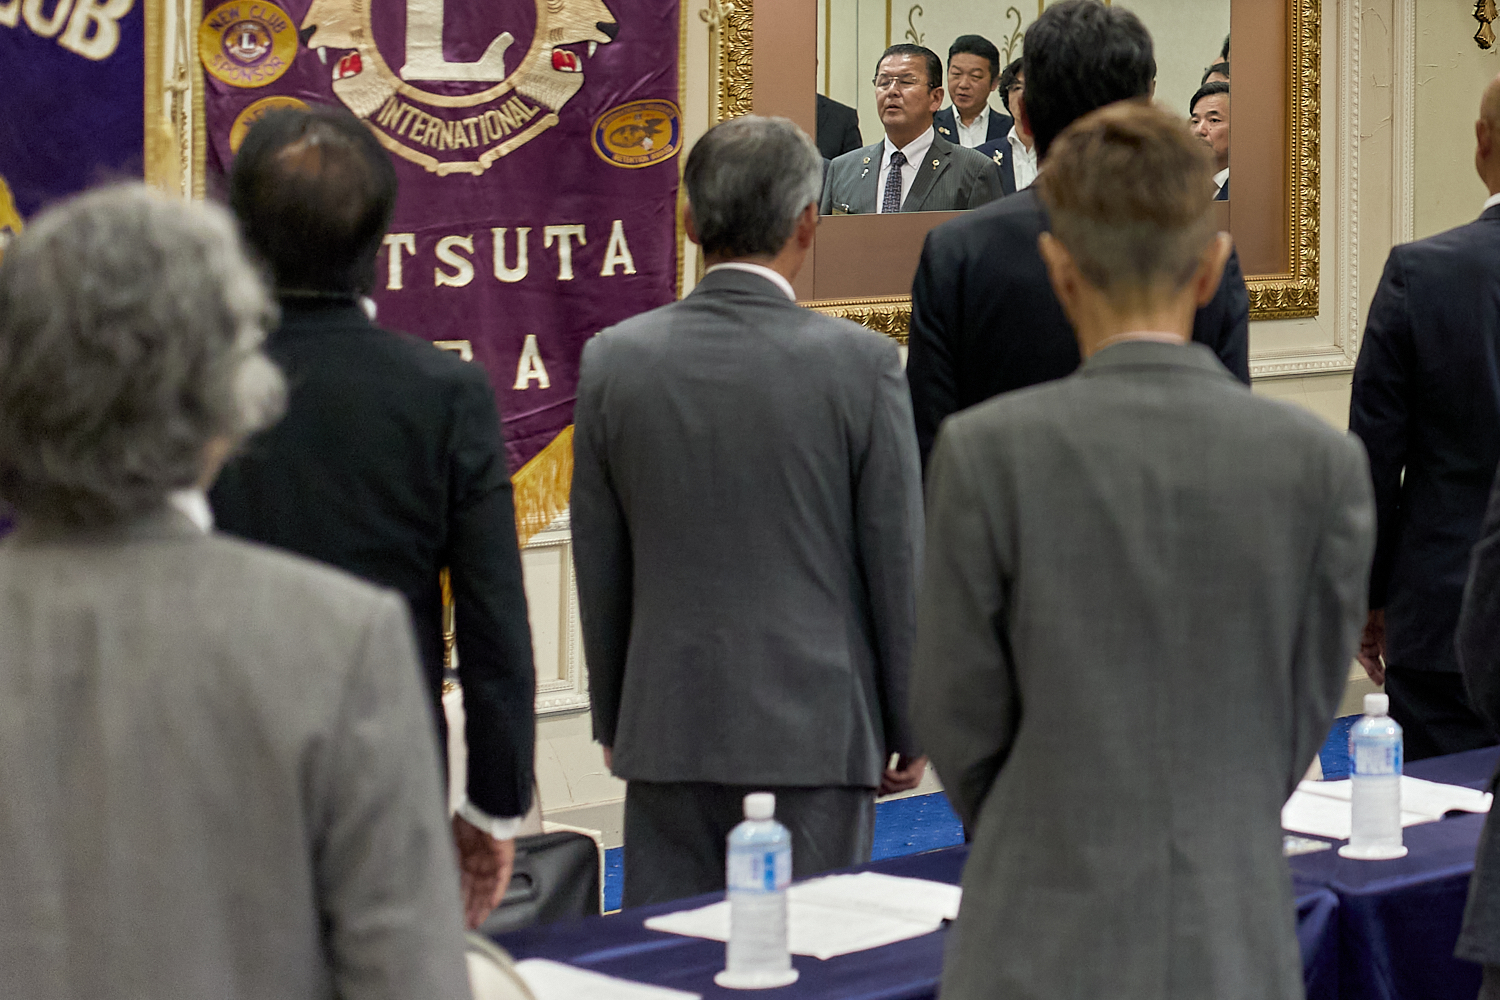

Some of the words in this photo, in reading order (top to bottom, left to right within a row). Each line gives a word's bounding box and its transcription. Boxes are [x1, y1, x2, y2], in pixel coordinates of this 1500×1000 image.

[208, 6, 240, 32] NEW
[249, 4, 288, 34] CLUB
[212, 53, 285, 82] SPONSOR
[376, 95, 541, 151] INTERNATIONAL
